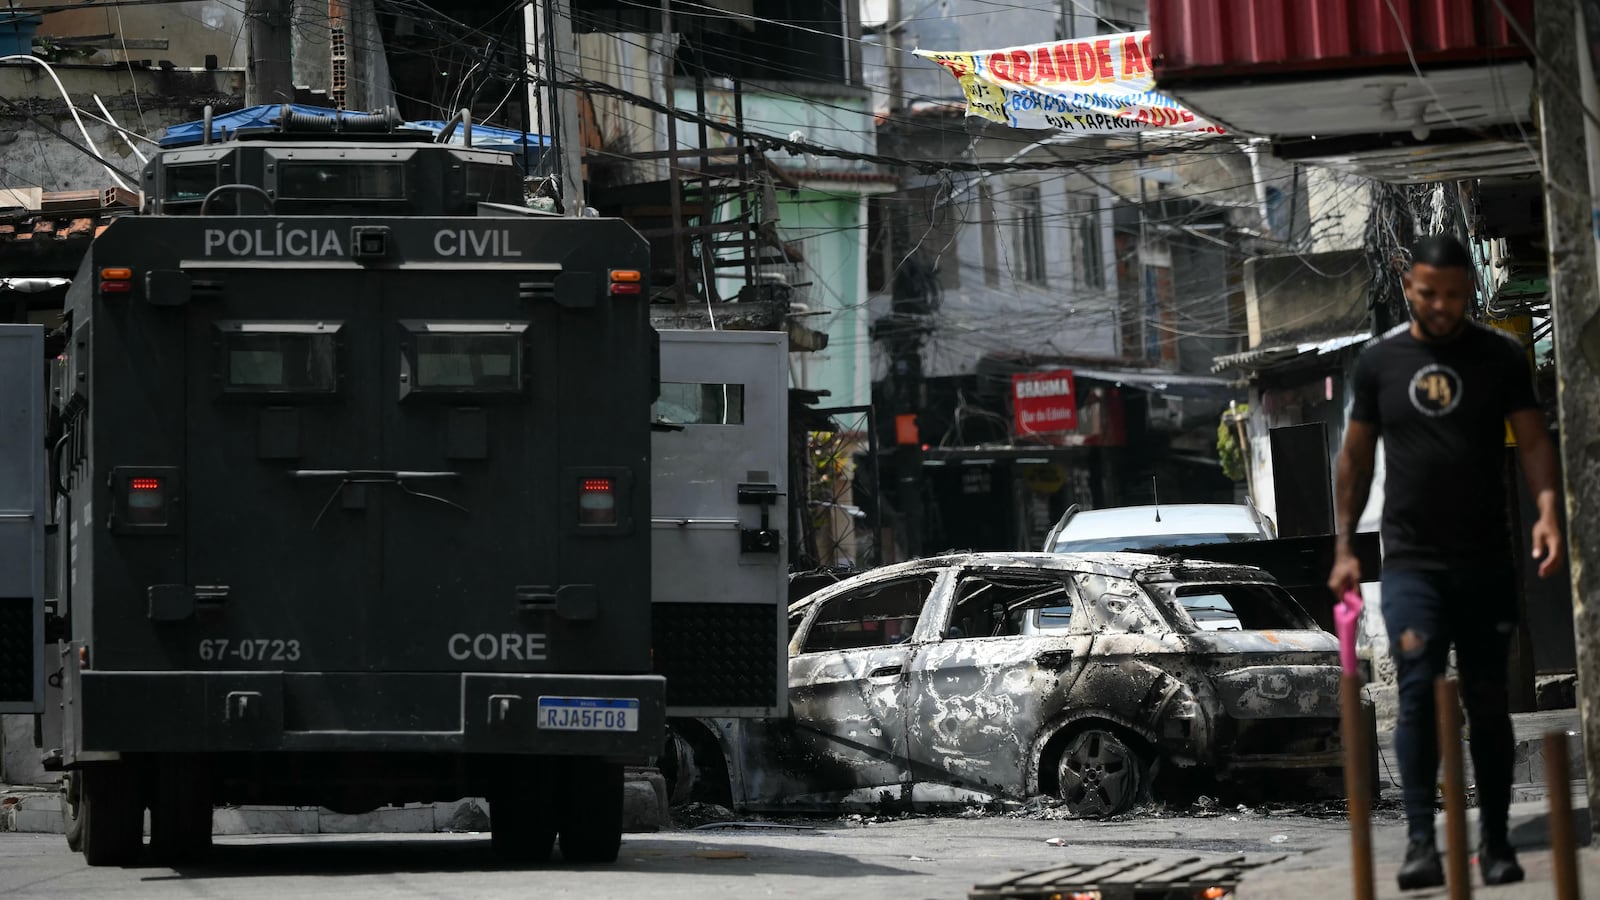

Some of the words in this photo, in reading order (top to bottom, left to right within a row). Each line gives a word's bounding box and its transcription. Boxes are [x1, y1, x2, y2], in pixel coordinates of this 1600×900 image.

[988, 39, 1114, 84] GRANDE
[205, 222, 344, 257] POLÍCIA
[433, 228, 522, 257] CIVIL
[1016, 379, 1069, 398] BRAHMA
[199, 639, 301, 661] 67-0723
[448, 633, 547, 660] CORE
[547, 708, 626, 729] RJA5F08
